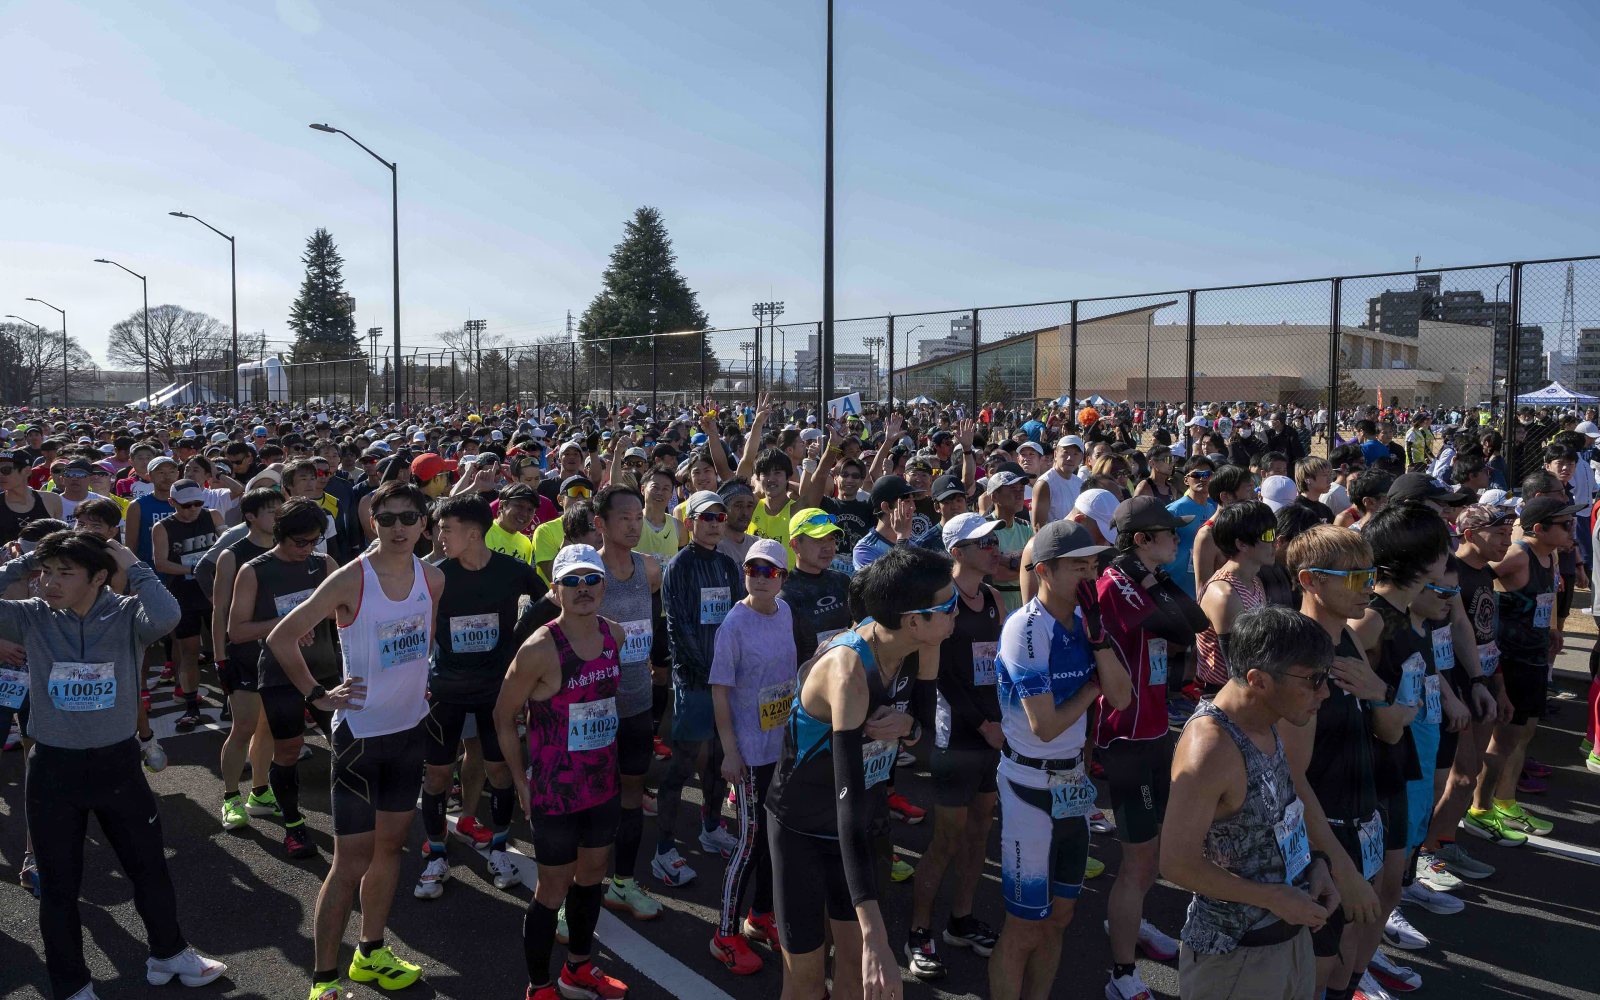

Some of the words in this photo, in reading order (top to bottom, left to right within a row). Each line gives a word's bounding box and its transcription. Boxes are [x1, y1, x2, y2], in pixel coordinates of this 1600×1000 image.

[842, 396, 856, 414] A
[813, 601, 844, 615] OAKLEY
[1026, 630, 1035, 659] KONA
[1052, 670, 1084, 680] KONA
